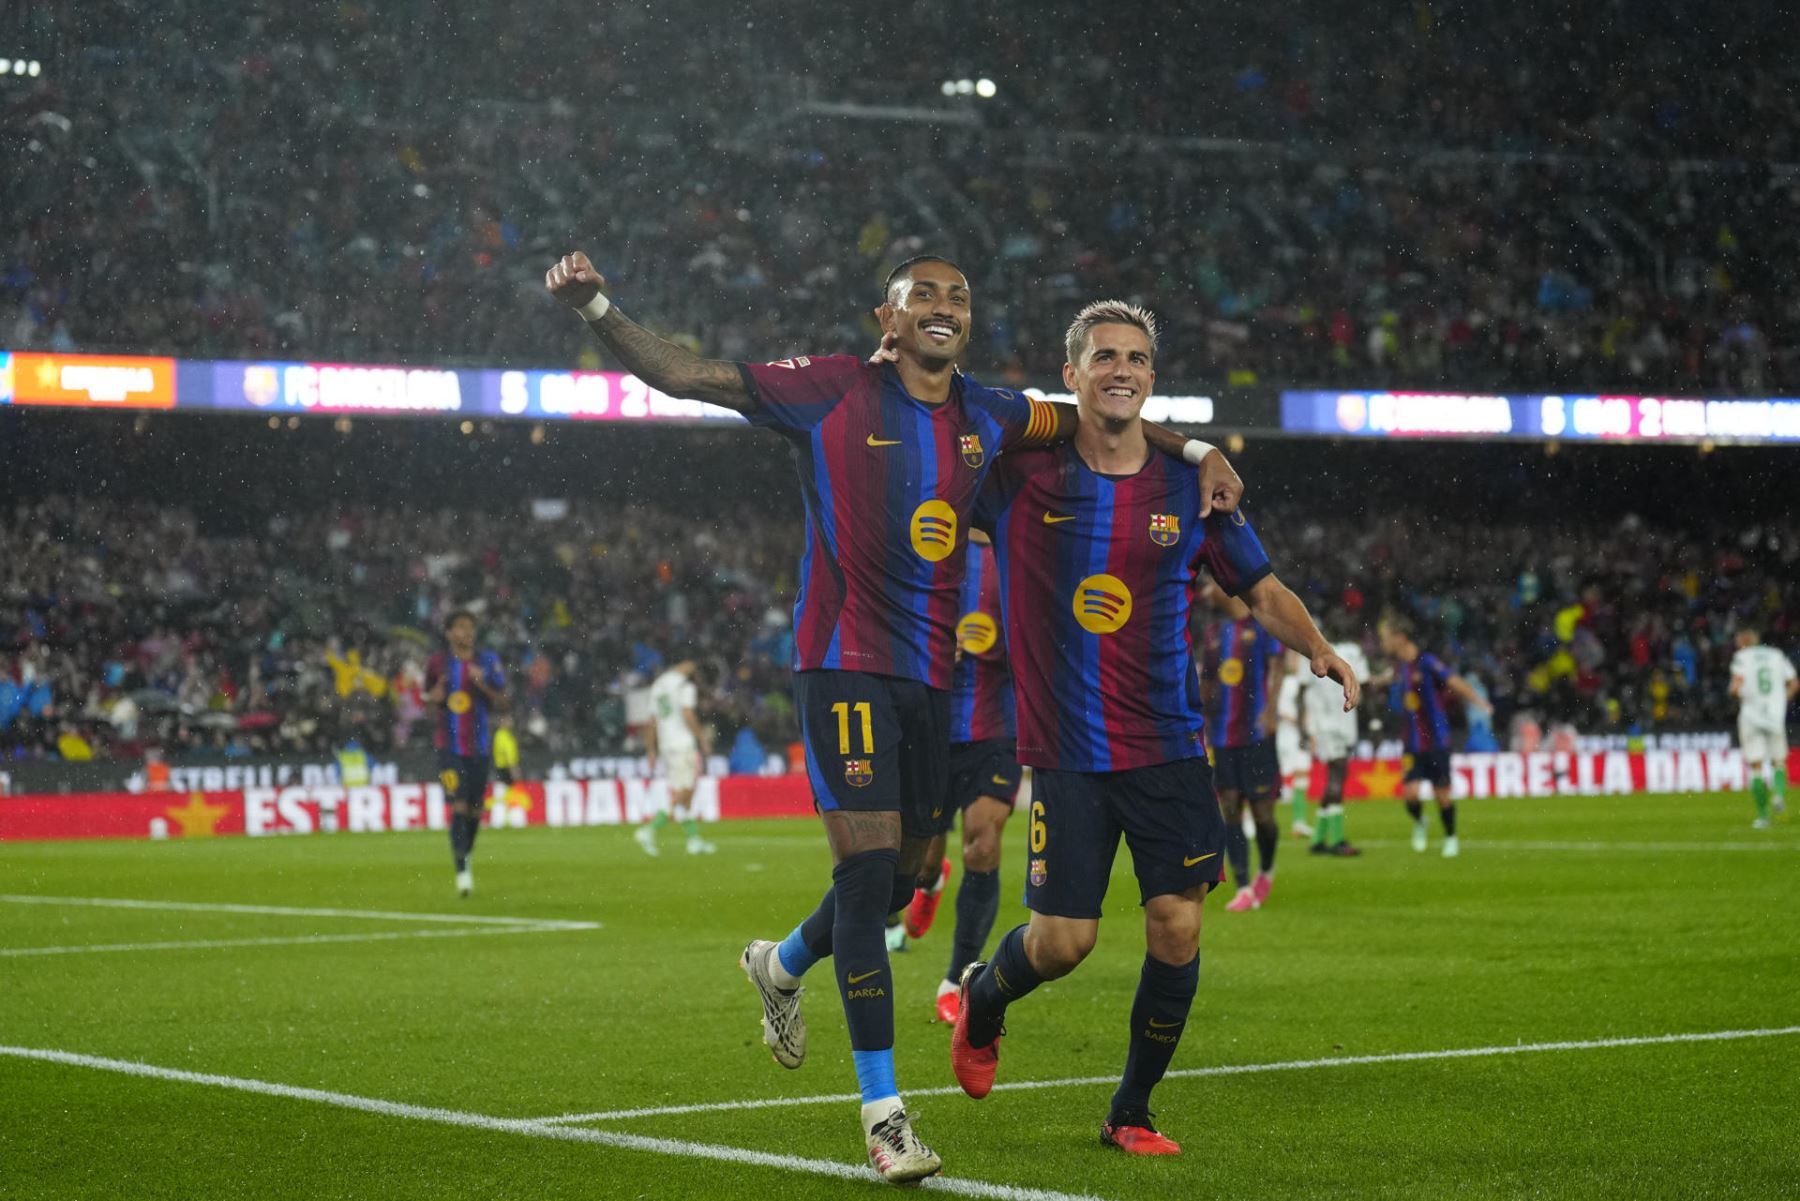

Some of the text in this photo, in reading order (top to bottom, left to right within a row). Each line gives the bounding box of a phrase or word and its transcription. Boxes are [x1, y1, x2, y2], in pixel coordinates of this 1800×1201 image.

[1757, 666, 1772, 695] 6
[831, 702, 874, 754] 11
[1420, 748, 1762, 798] STRELLA DAM
[244, 780, 529, 837] ESTRELA
[1031, 801, 1046, 853] 6
[847, 987, 885, 1000] BARÇA
